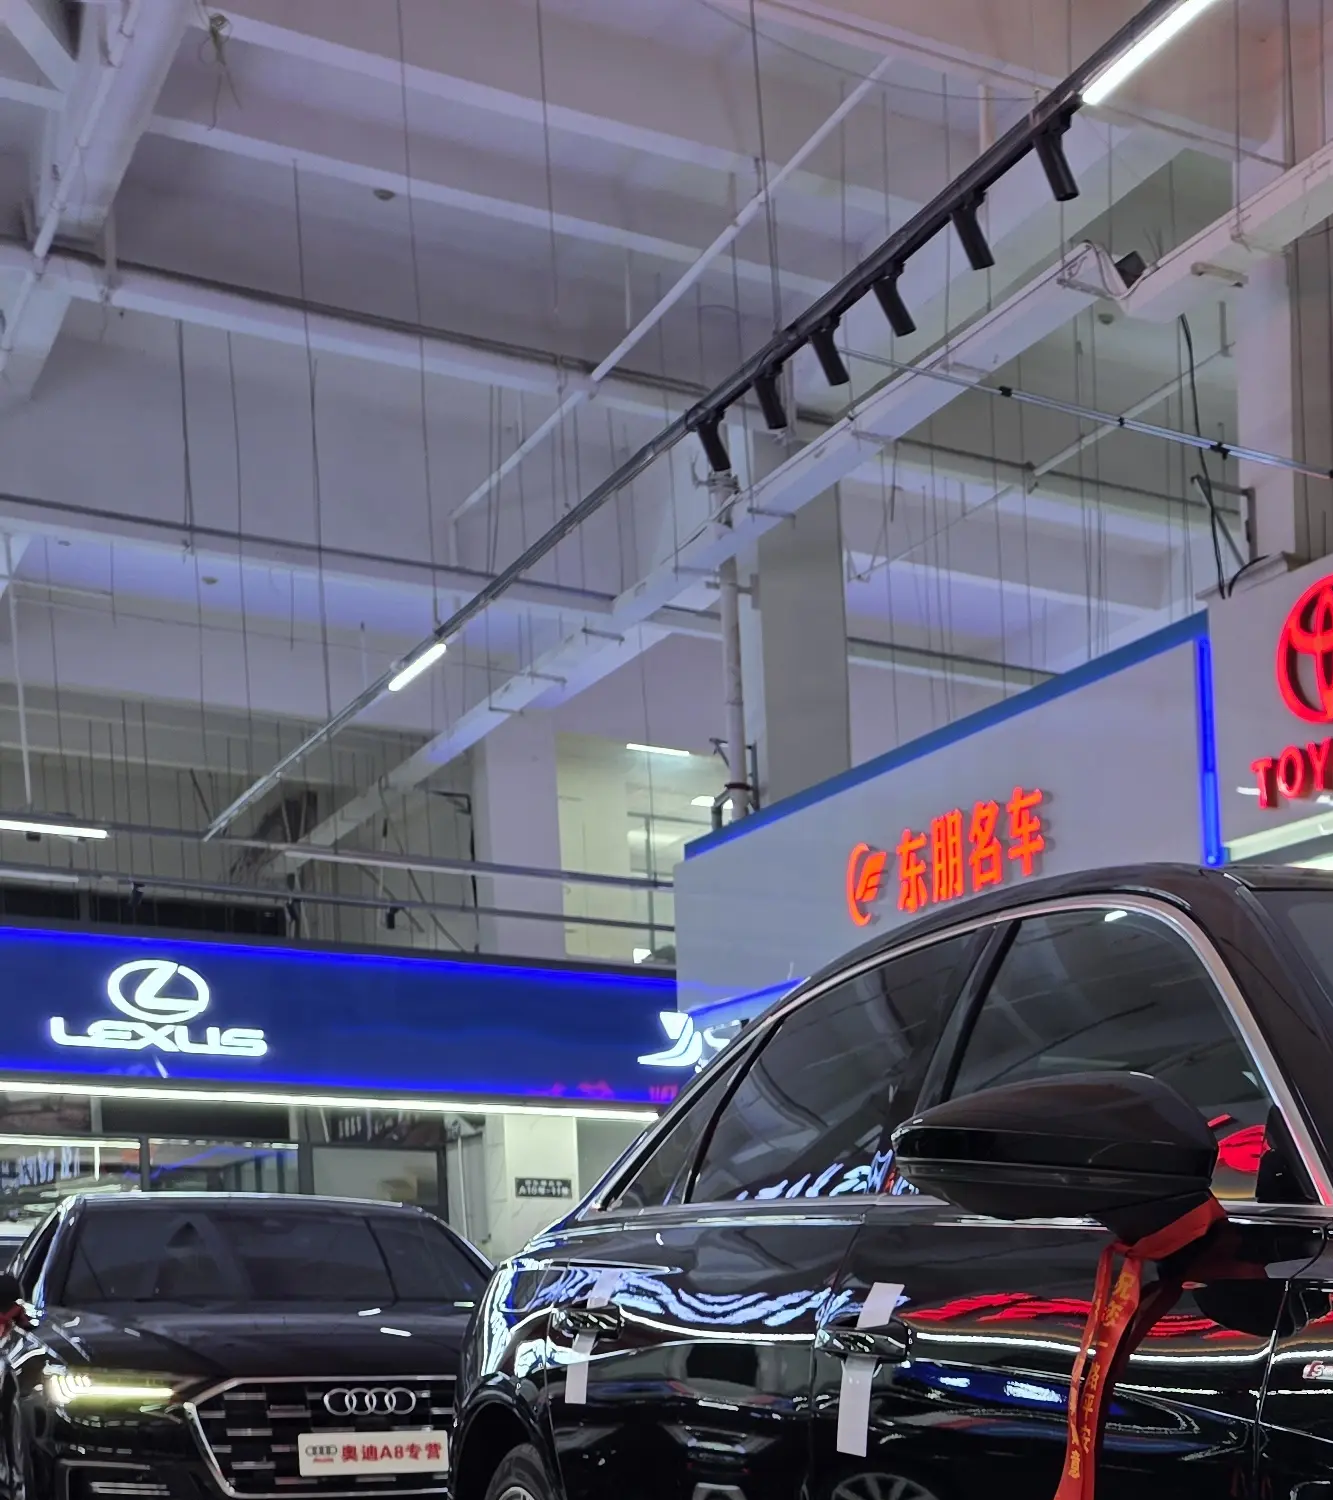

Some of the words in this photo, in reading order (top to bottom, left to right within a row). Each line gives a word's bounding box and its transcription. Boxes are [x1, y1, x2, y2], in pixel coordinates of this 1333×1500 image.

[895, 785, 1047, 913] 东朋名车
[49, 1016, 268, 1058] LEXUS
